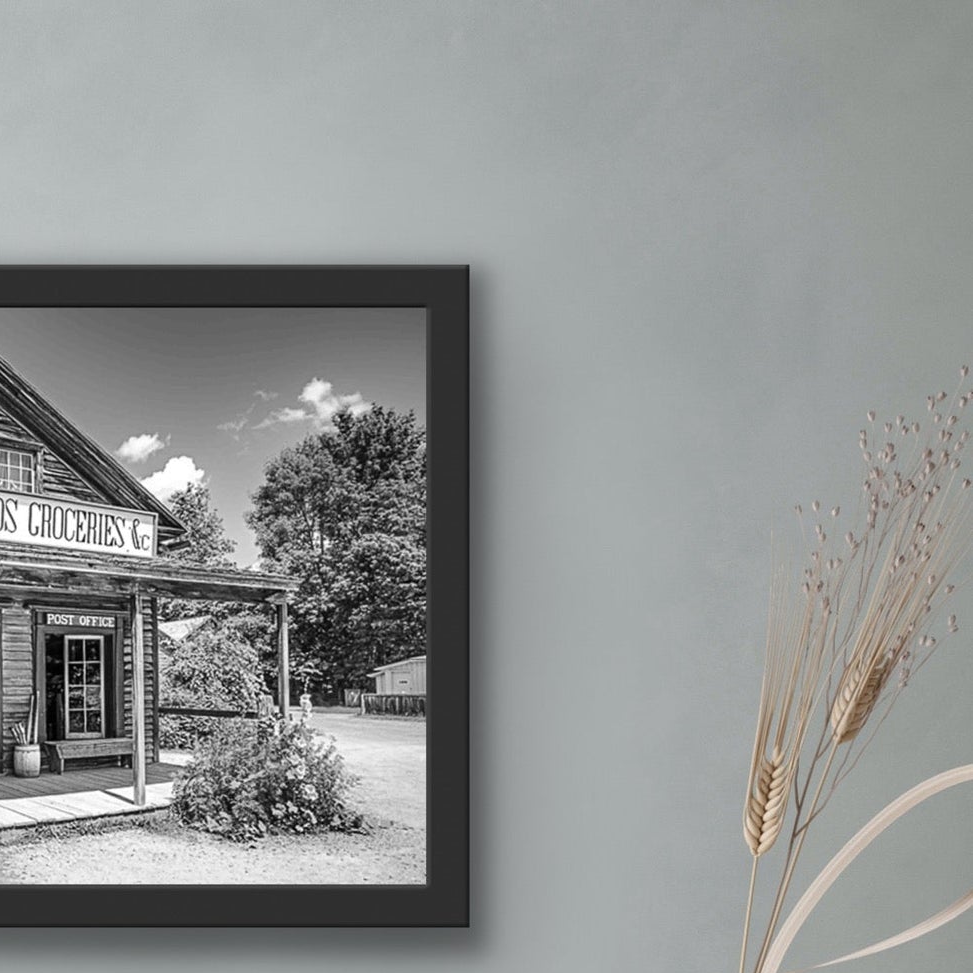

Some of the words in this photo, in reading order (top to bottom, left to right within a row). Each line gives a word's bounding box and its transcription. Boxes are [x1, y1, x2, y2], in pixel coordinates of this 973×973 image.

[28, 502, 125, 548] GROCERIES
[47, 613, 75, 625] POST
[79, 615, 115, 627] OFFICE
